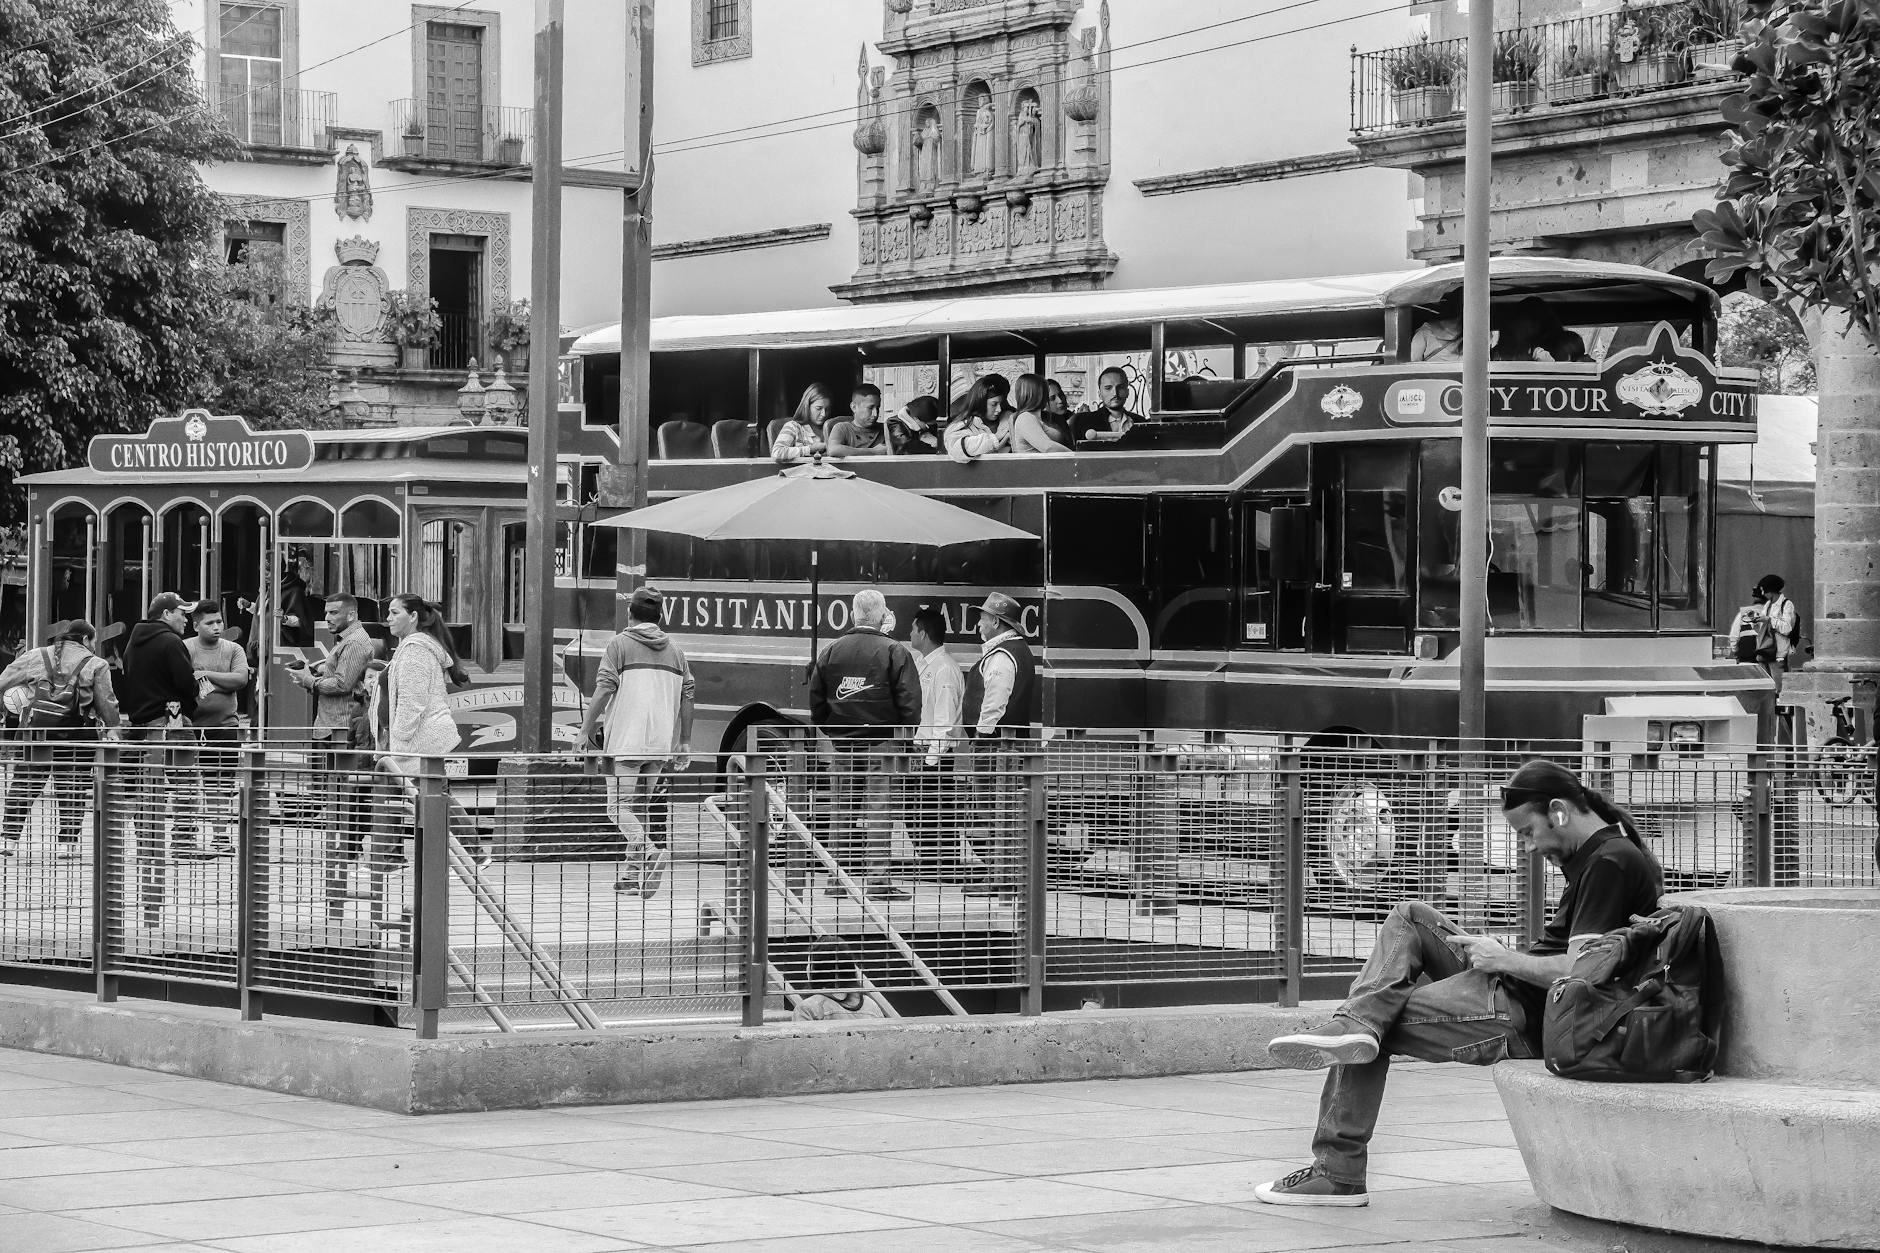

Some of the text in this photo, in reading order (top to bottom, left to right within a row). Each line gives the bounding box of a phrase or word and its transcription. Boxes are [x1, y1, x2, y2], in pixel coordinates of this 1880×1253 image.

[1442, 386, 1611, 412] CY TOUR
[1709, 391, 1758, 417] CITY T
[111, 440, 288, 468] CENTRO HISTORICO
[660, 596, 850, 631] VISITANDO
[842, 676, 867, 690] NIKE
